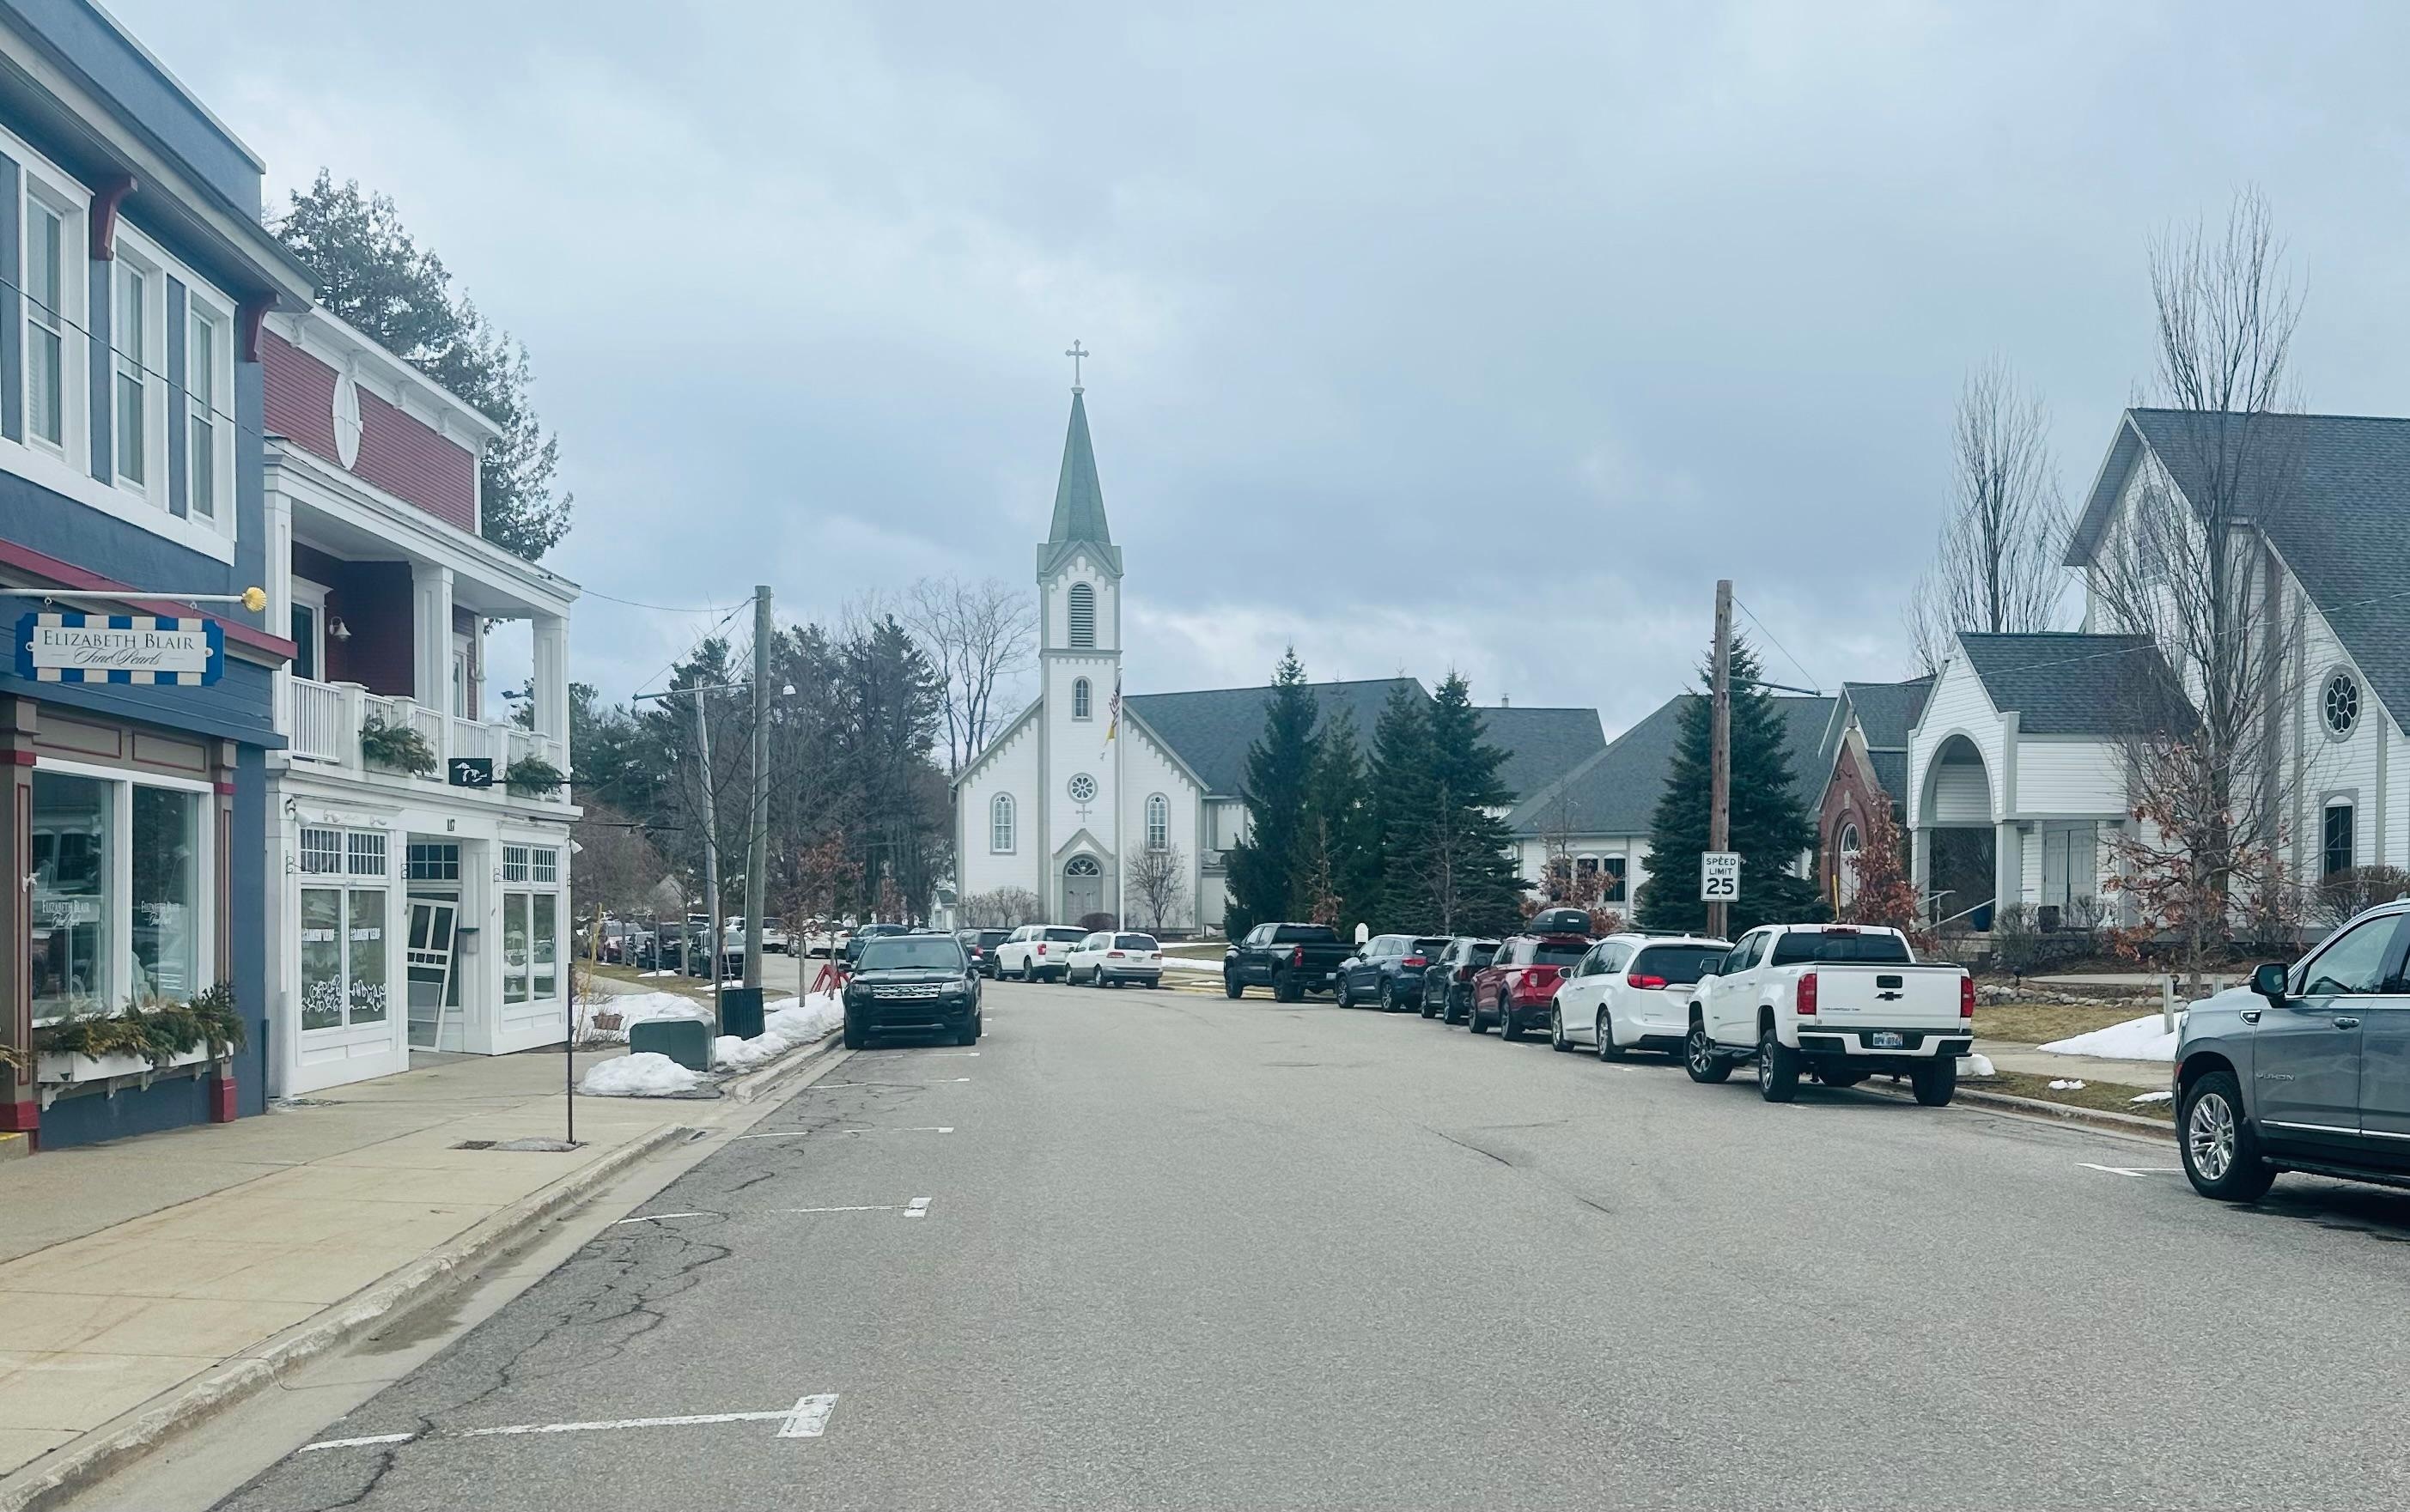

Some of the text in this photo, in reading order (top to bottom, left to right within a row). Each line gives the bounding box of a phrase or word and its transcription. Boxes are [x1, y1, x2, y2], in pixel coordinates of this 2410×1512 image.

[44, 629, 195, 650] ELIZABETH BLAIR
[73, 646, 162, 666] Fine Pearls
[1706, 877, 1734, 895] 25
